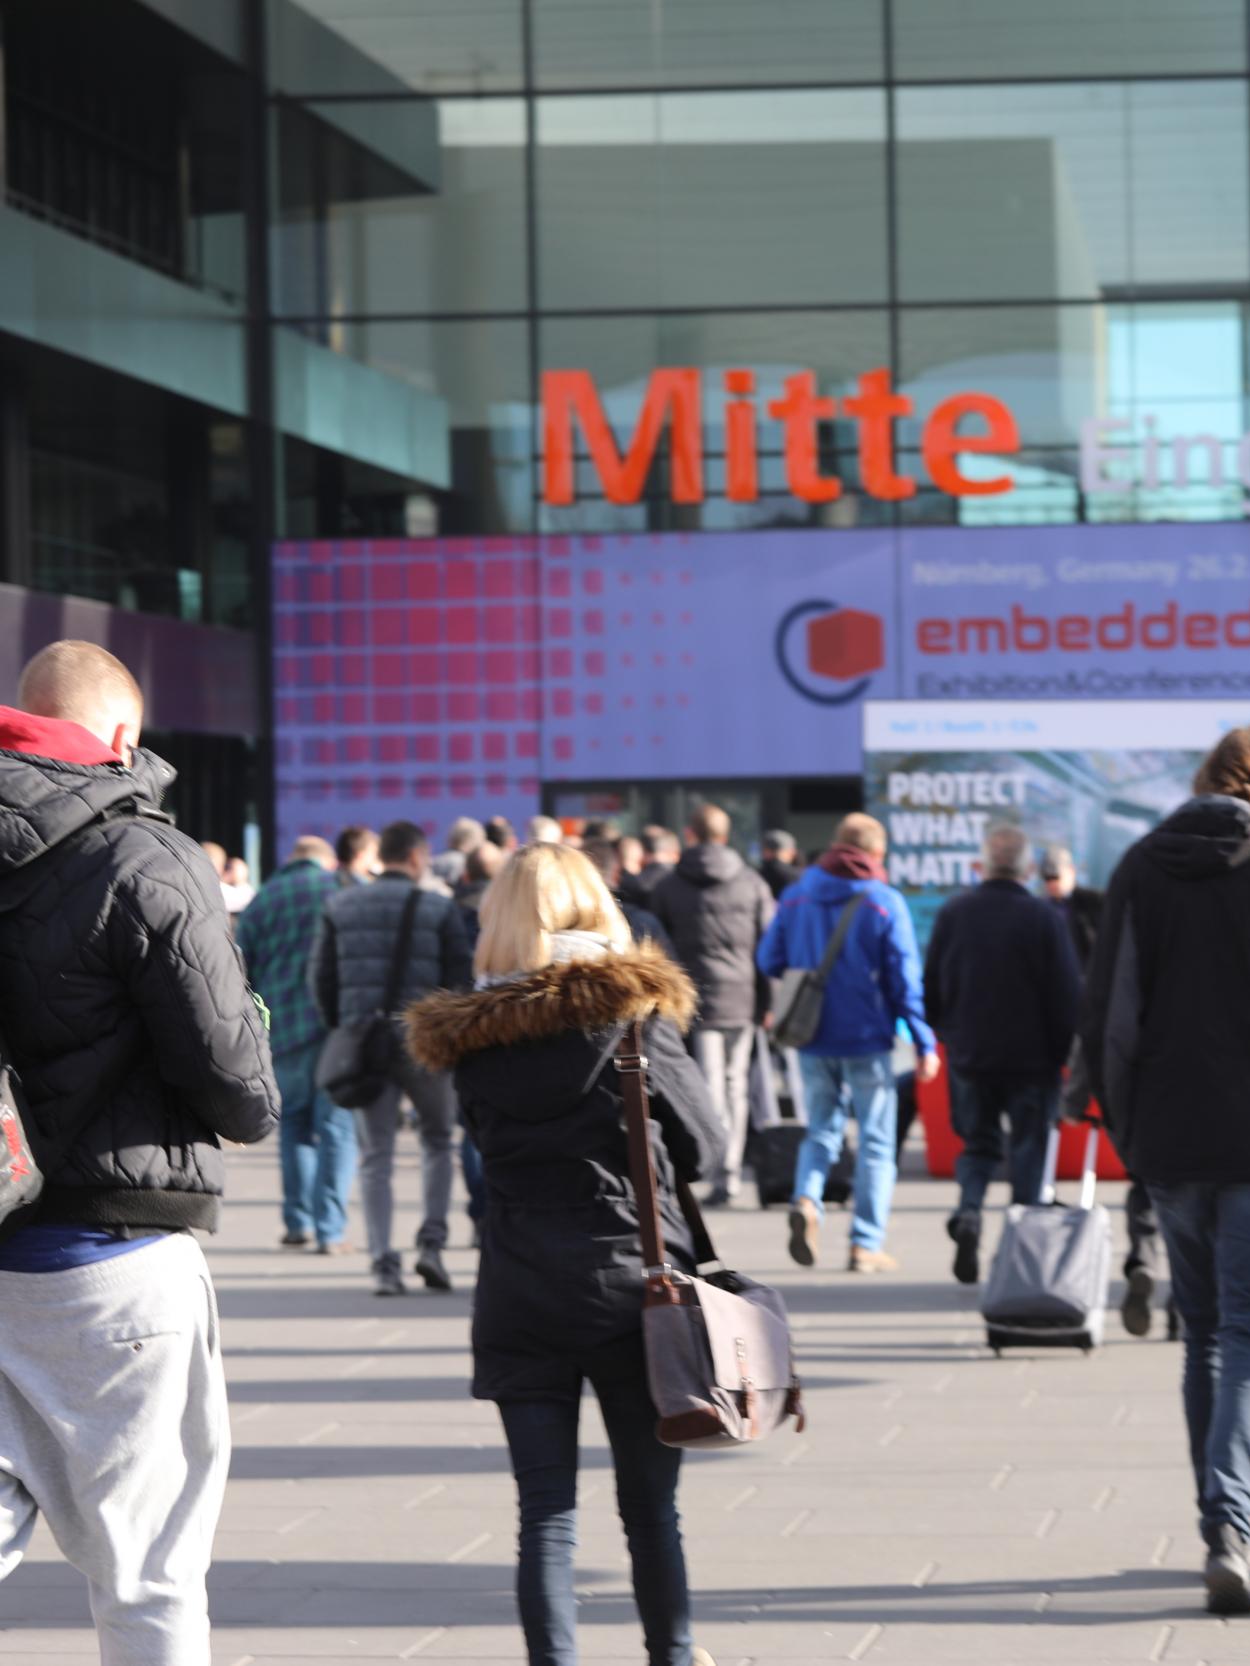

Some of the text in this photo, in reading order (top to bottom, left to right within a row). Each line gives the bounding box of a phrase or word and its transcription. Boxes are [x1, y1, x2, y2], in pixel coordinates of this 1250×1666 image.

[540, 367, 1020, 506] Mitte
[1057, 558, 1178, 587] Germany
[888, 772, 1027, 805] PROTECT
[889, 812, 988, 846] WHAT
[889, 851, 981, 886] MATT
